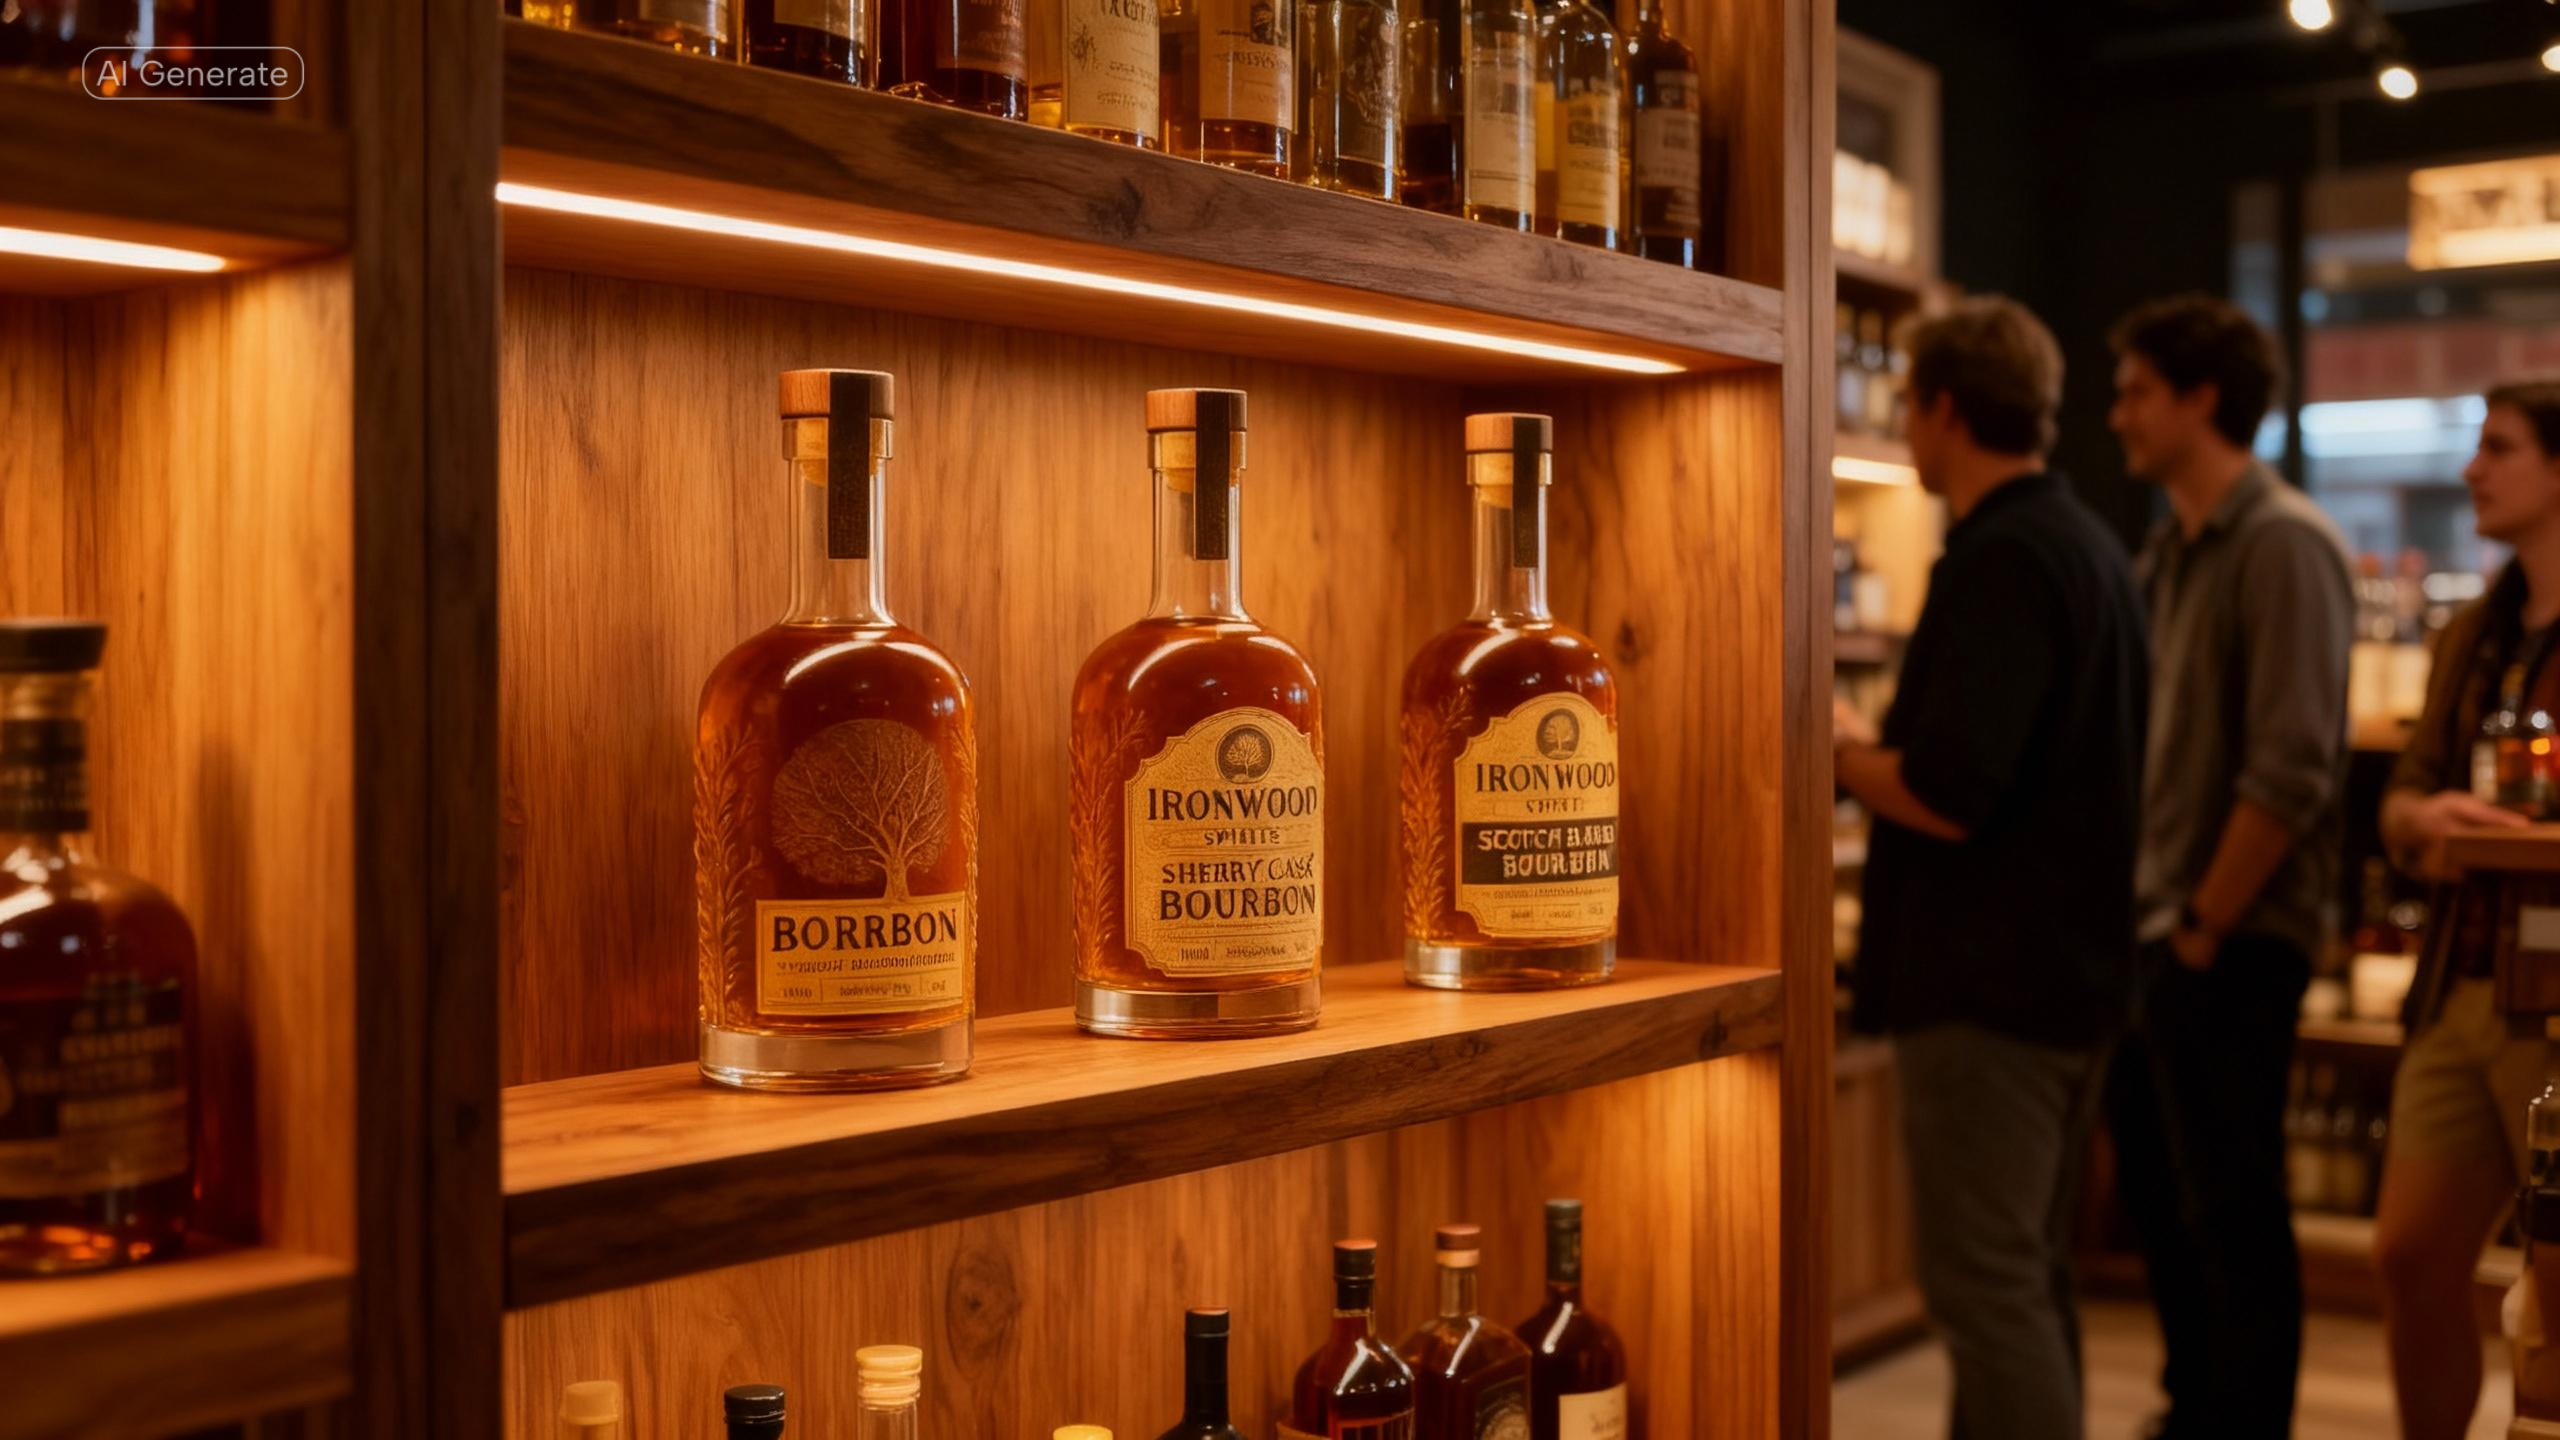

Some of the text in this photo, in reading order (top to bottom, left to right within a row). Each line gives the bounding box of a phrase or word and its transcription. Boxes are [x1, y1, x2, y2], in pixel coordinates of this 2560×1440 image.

[1477, 762, 1615, 793] IRONWOOD
[1147, 785, 1318, 821] IRONWOOD
[1161, 858, 1265, 885] SHERRY
[1159, 884, 1316, 921] BOURBON
[771, 908, 957, 952] BORRBON
